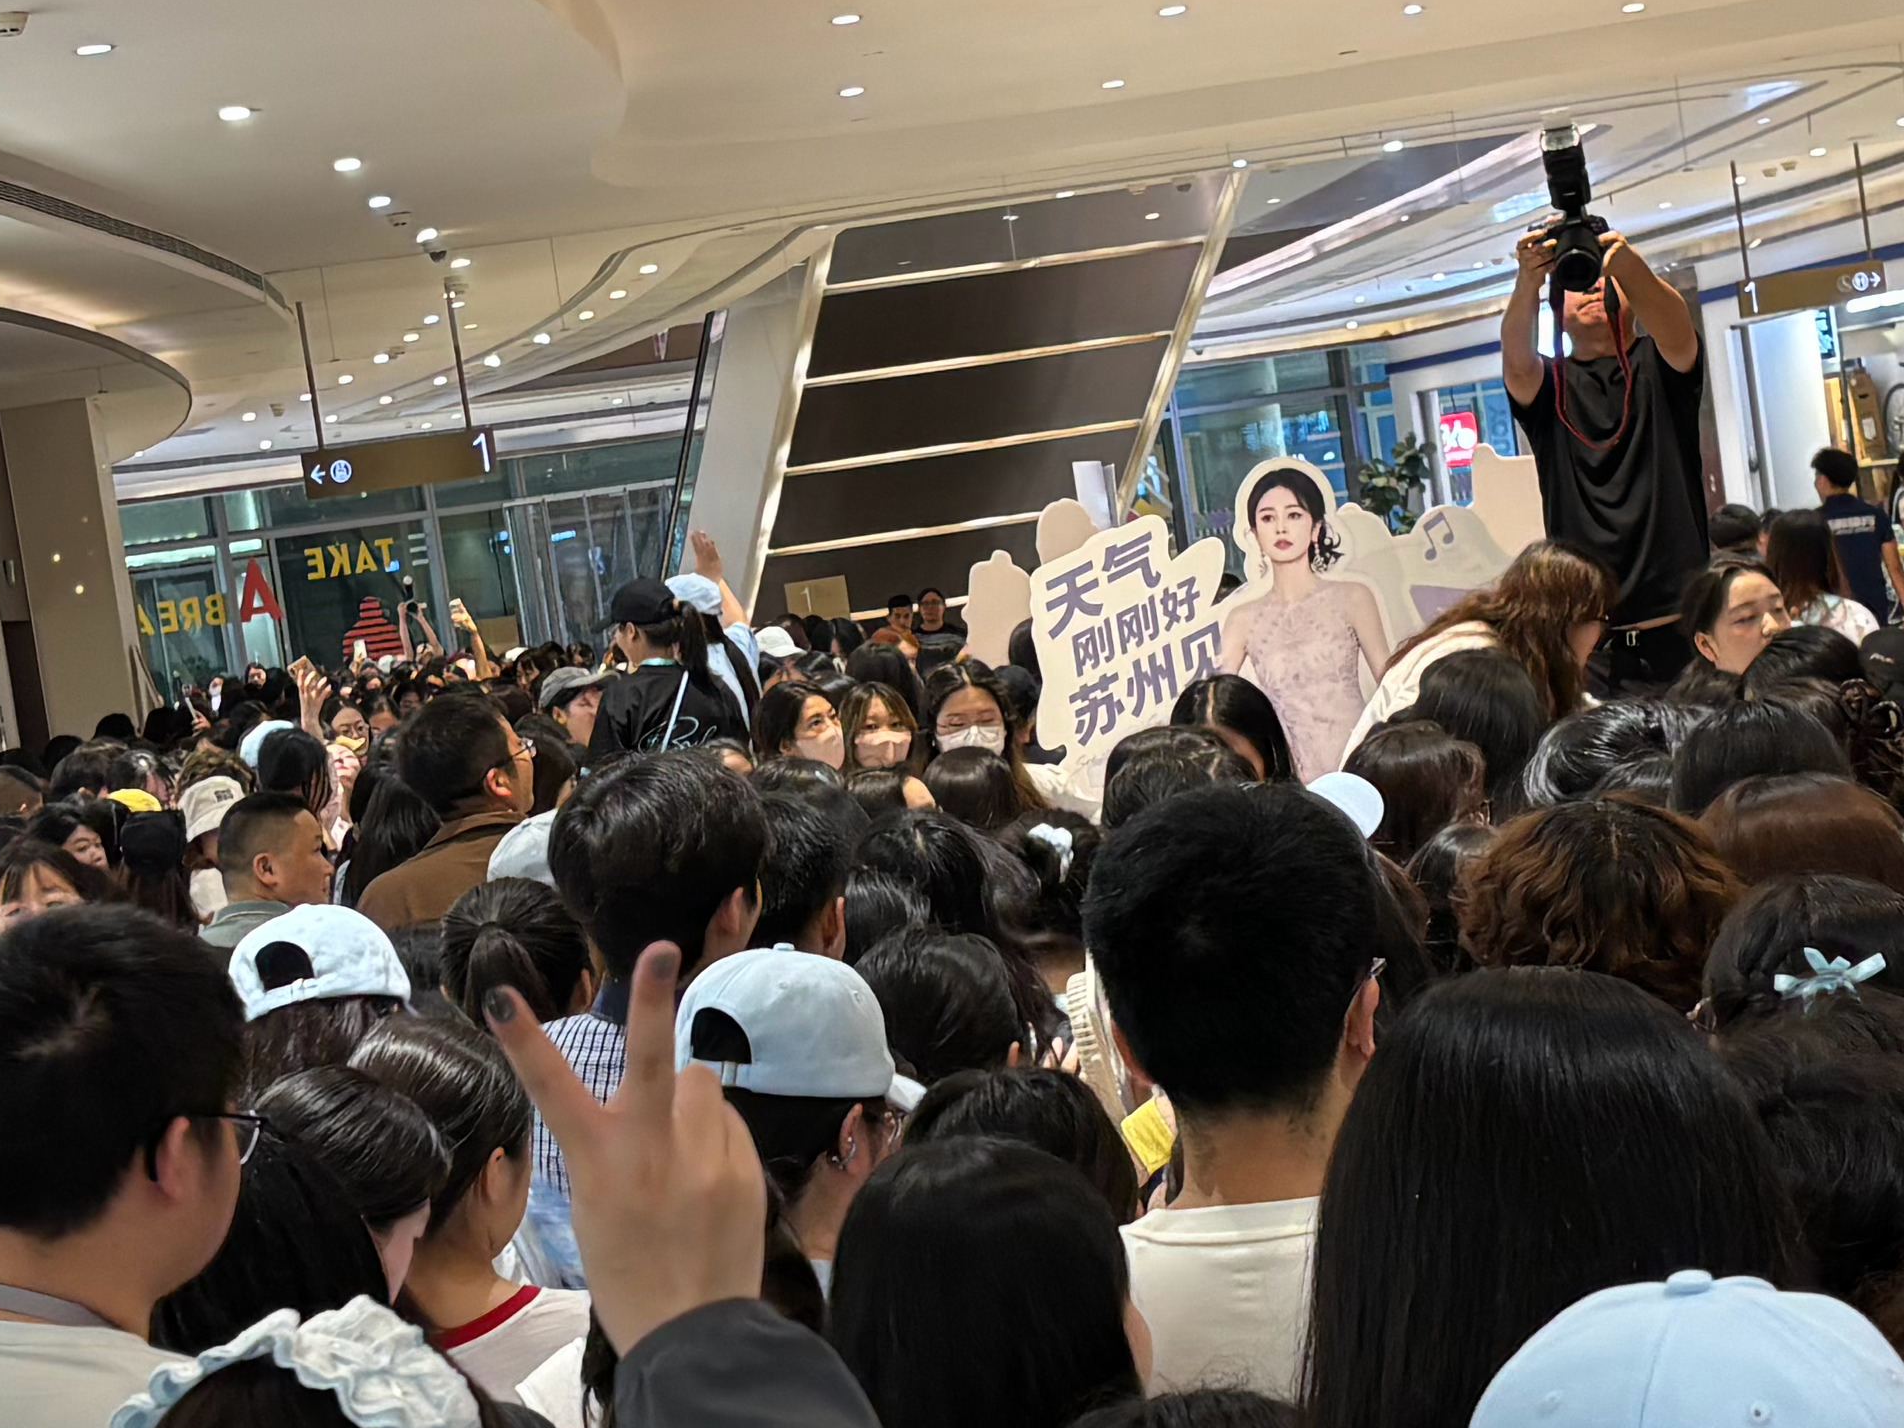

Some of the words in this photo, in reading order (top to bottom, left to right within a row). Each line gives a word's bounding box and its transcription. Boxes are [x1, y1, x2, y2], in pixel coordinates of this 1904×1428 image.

[1744, 281, 1759, 314] 1
[472, 432, 491, 474] 1
[1046, 531, 1162, 640] 天气
[1071, 576, 1201, 677] 刚刚好
[1069, 621, 1222, 747] 苏州见
